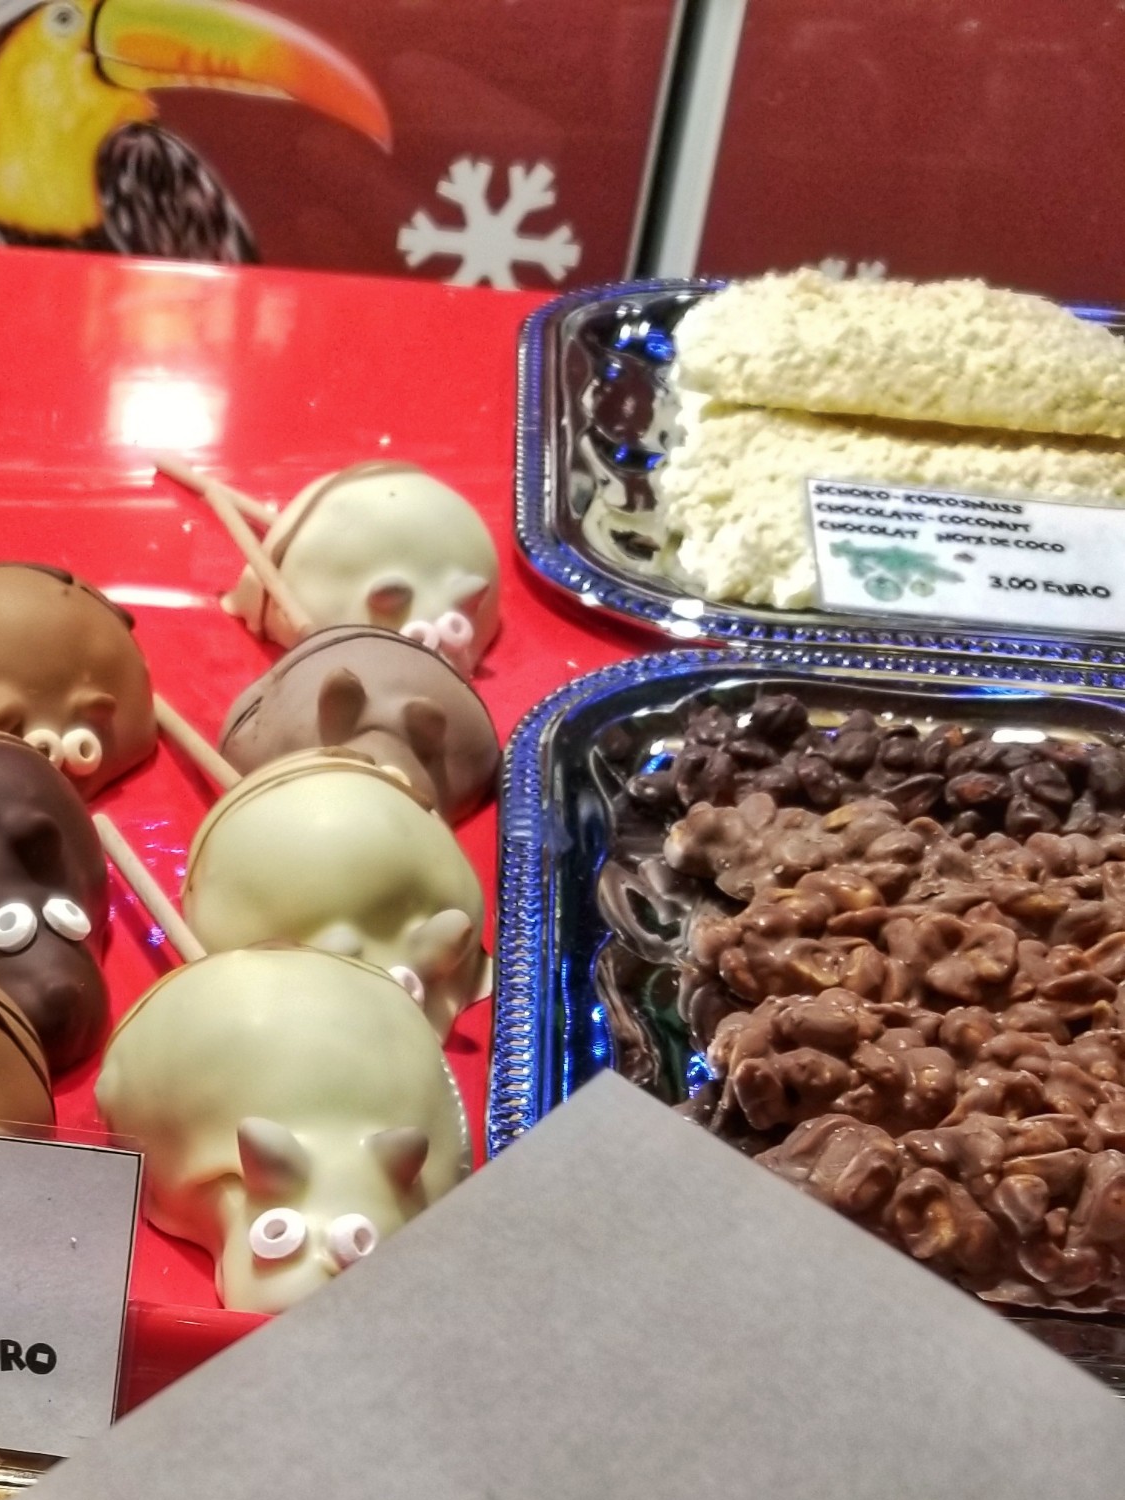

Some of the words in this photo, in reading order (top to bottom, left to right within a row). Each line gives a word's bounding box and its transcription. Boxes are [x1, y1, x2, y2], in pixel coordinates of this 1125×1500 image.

[817, 520, 919, 539] CHOCOLAT
[1013, 538, 1065, 553] COCO
[1043, 581, 1112, 599] EURO
